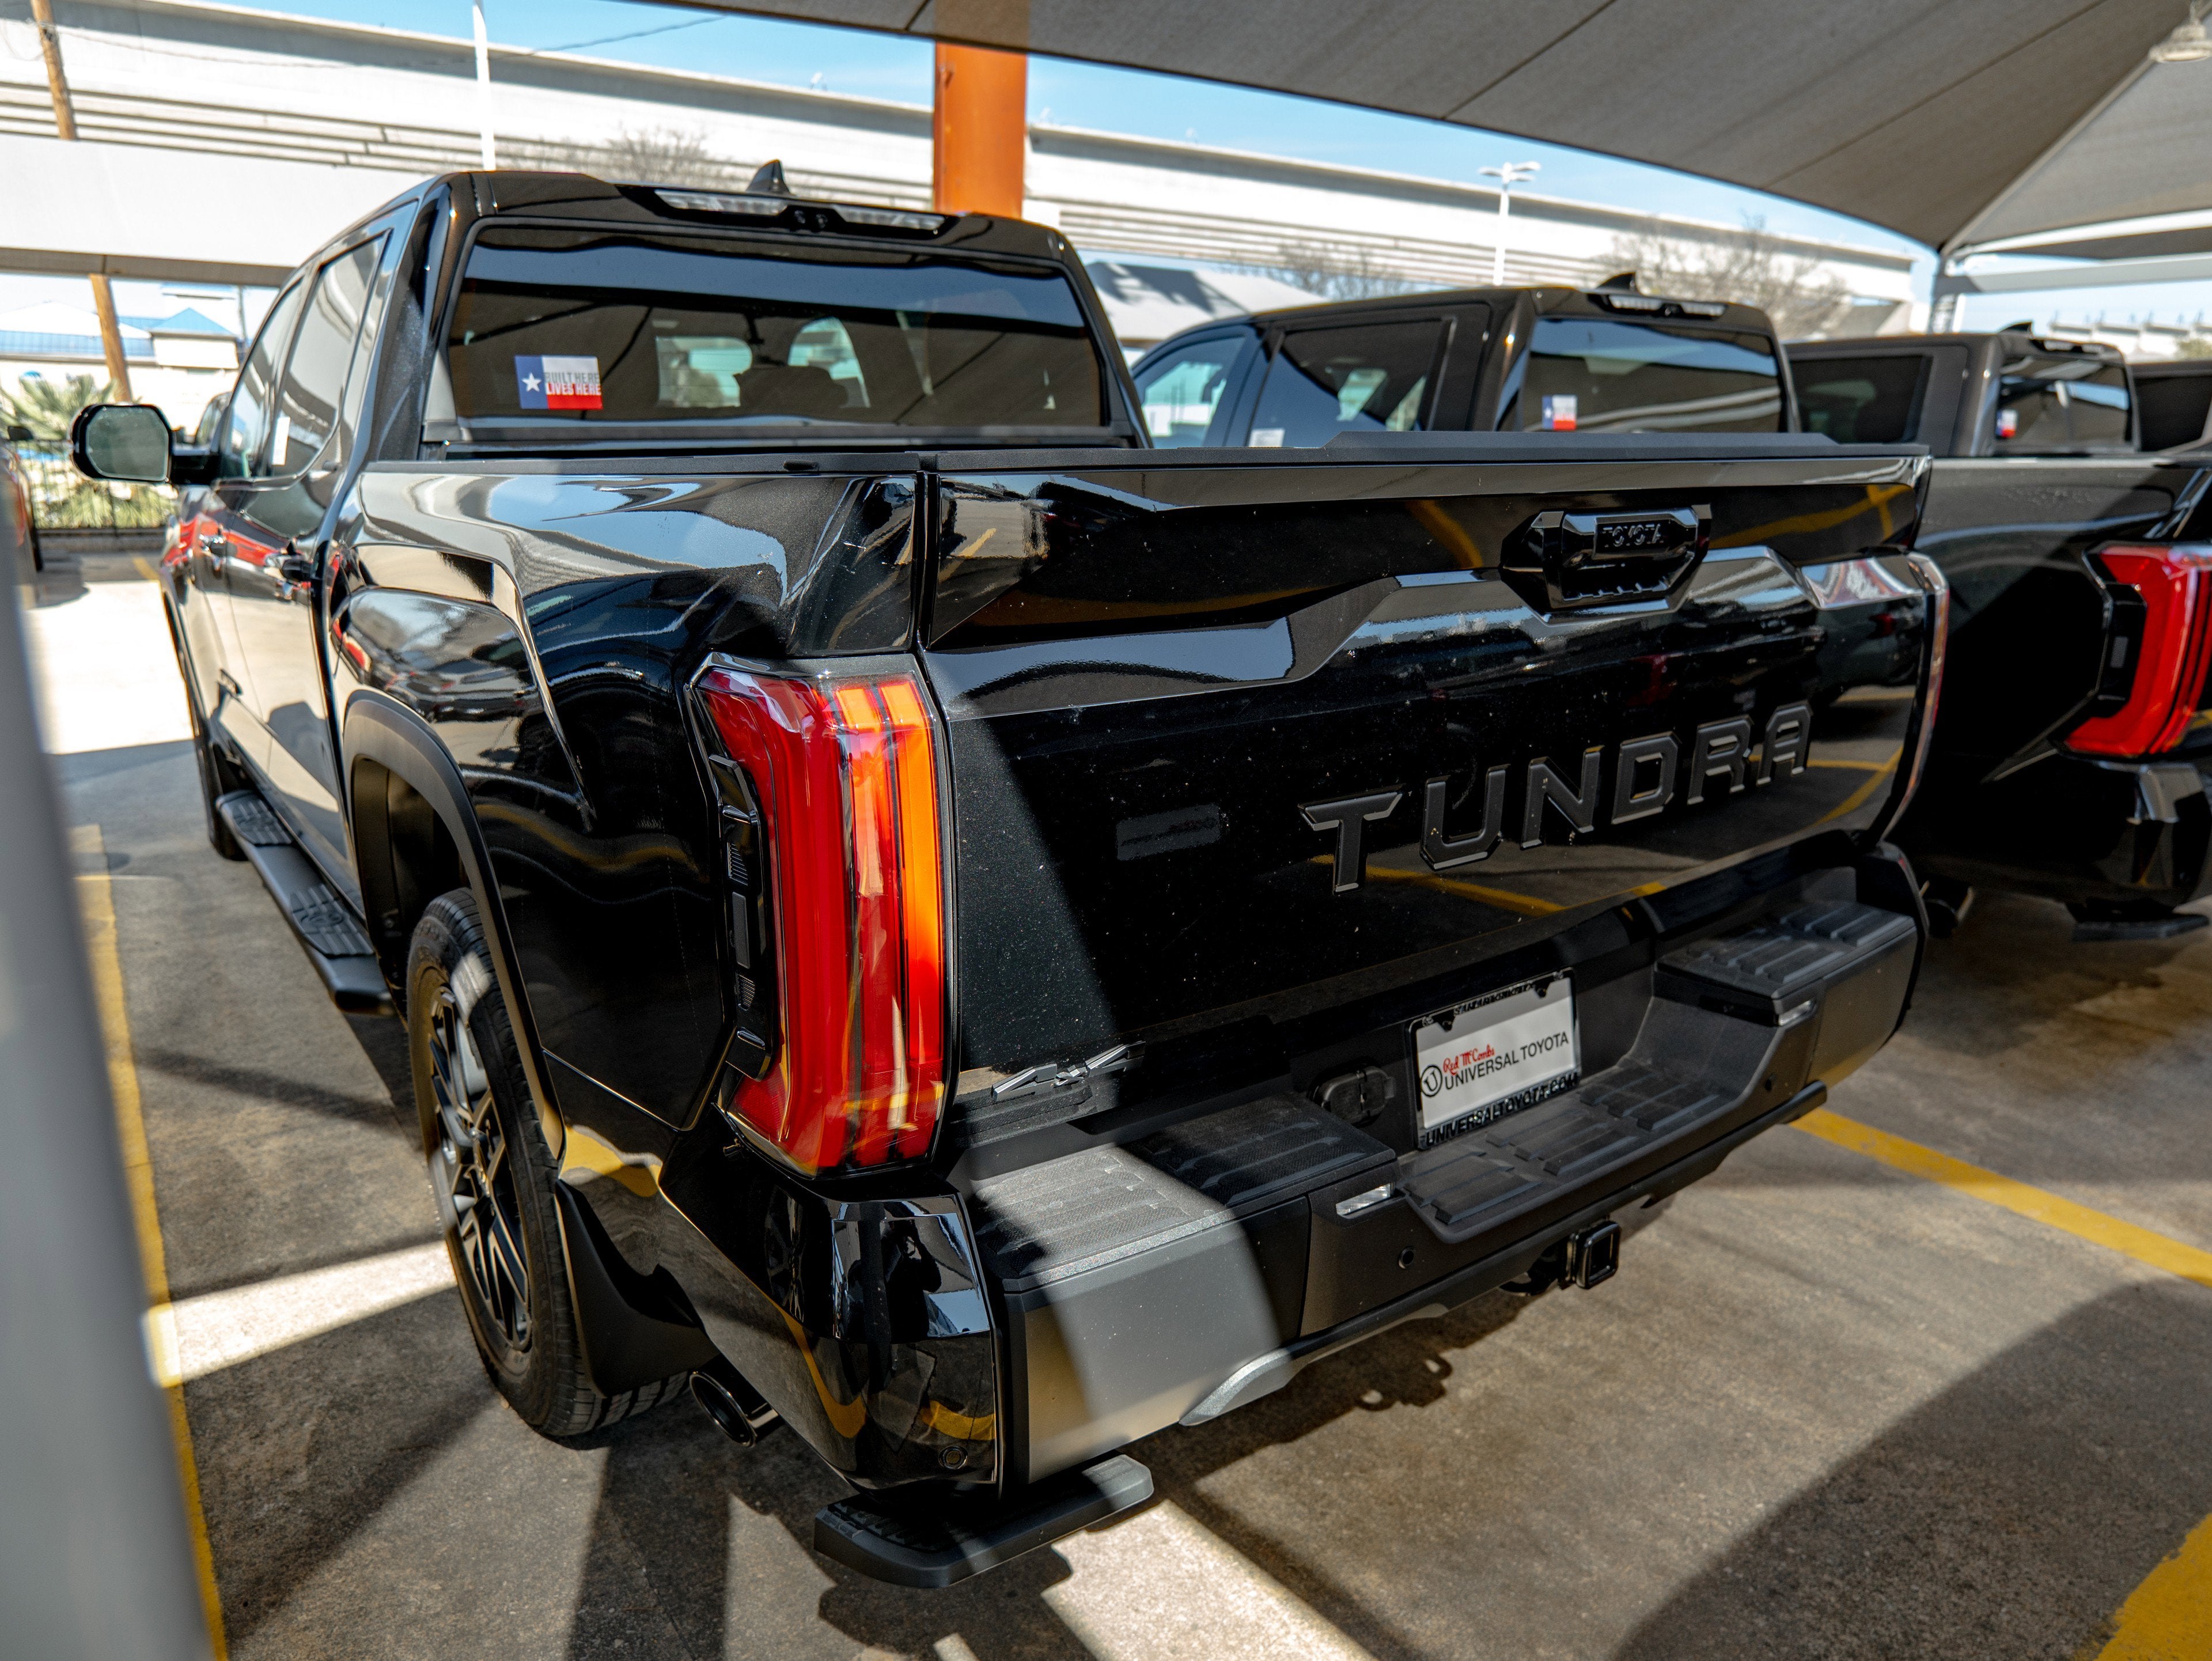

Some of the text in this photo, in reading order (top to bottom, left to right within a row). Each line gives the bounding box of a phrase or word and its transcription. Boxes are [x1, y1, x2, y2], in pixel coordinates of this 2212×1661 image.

[545, 372, 599, 384] BUILT HERE
[547, 383, 601, 395] LIVES HERE
[1298, 699, 1813, 895] TUNDRA
[1443, 1043, 1495, 1076] Red McCombs
[1445, 1031, 1569, 1090] UNIVERSAL TOYOTA
